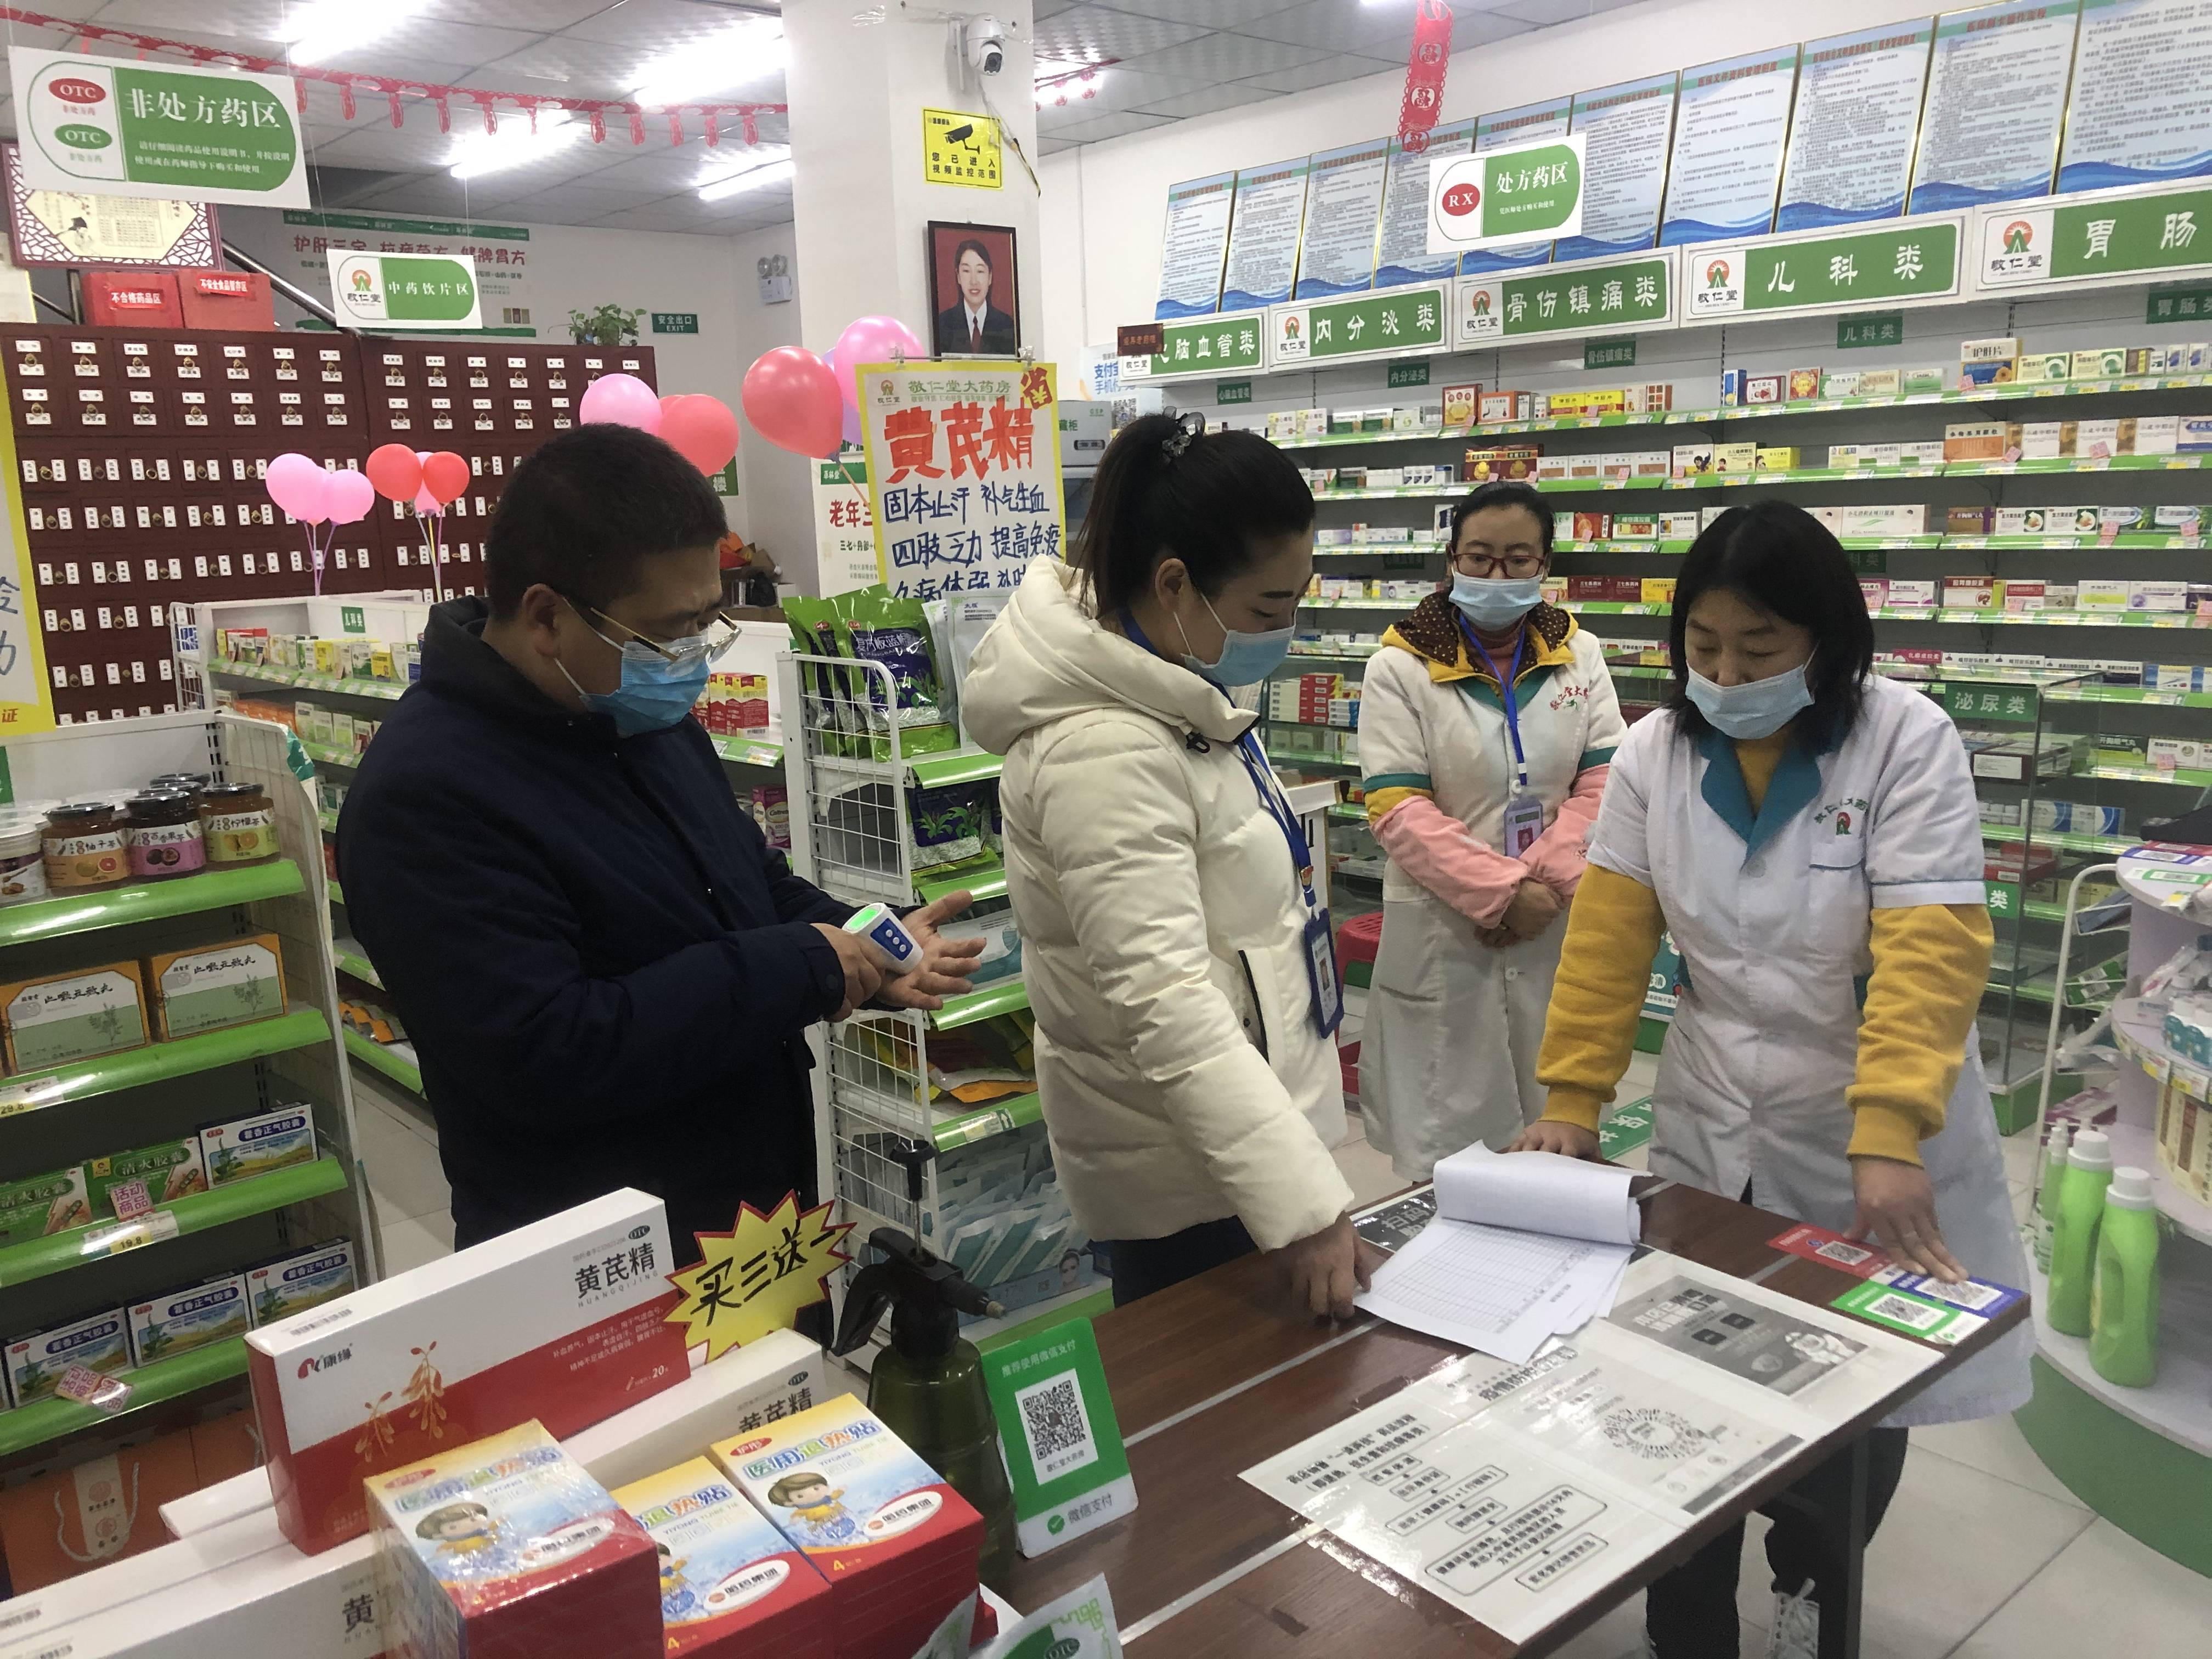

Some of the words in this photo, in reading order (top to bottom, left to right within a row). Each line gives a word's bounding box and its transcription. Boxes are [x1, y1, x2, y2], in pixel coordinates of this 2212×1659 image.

[60, 84, 97, 99] OTC
[125, 88, 281, 128] 非处方药区
[65, 130, 101, 143] OTC
[933, 164, 996, 180] 视频监控范围
[1494, 161, 1568, 194] 处方药区
[1448, 192, 1474, 207] RX
[2083, 211, 2198, 260] 胃肠
[1767, 243, 1924, 294] 儿科类
[111, 292, 161, 304] 不合格药品区
[388, 281, 469, 296] 中药饮片区
[1506, 275, 1658, 323] 骨伤镇痛类
[658, 315, 691, 324] 安全出口
[1314, 303, 1436, 344] 内分泌类
[1843, 323, 1895, 341] 儿科类
[1391, 369, 1427, 383] 内分泌类
[908, 381, 1011, 393] 敬仁堂大药房
[884, 484, 969, 525] 固本止汗
[980, 481, 1049, 516] 补气生血
[892, 529, 982, 570] 四肢乏力
[990, 521, 1064, 560] 提高免疫
[1955, 691, 2025, 715] 泌尿类
[1990, 889, 2008, 910] 类
[114, 1182, 145, 1201] 活动
[119, 1194, 149, 1214] 商品
[120, 1236, 143, 1250] 19.8
[574, 1242, 655, 1300] 黄芪精
[690, 1218, 836, 1327] 买三送一
[578, 1271, 659, 1308] HUANGQIJING
[745, 1420, 883, 1479] 医用退热贴
[635, 1483, 733, 1531] 退热贴
[1068, 1493, 1113, 1525] 微信支付
[832, 1559, 846, 1572] 4
[667, 1635, 680, 1651] 4
